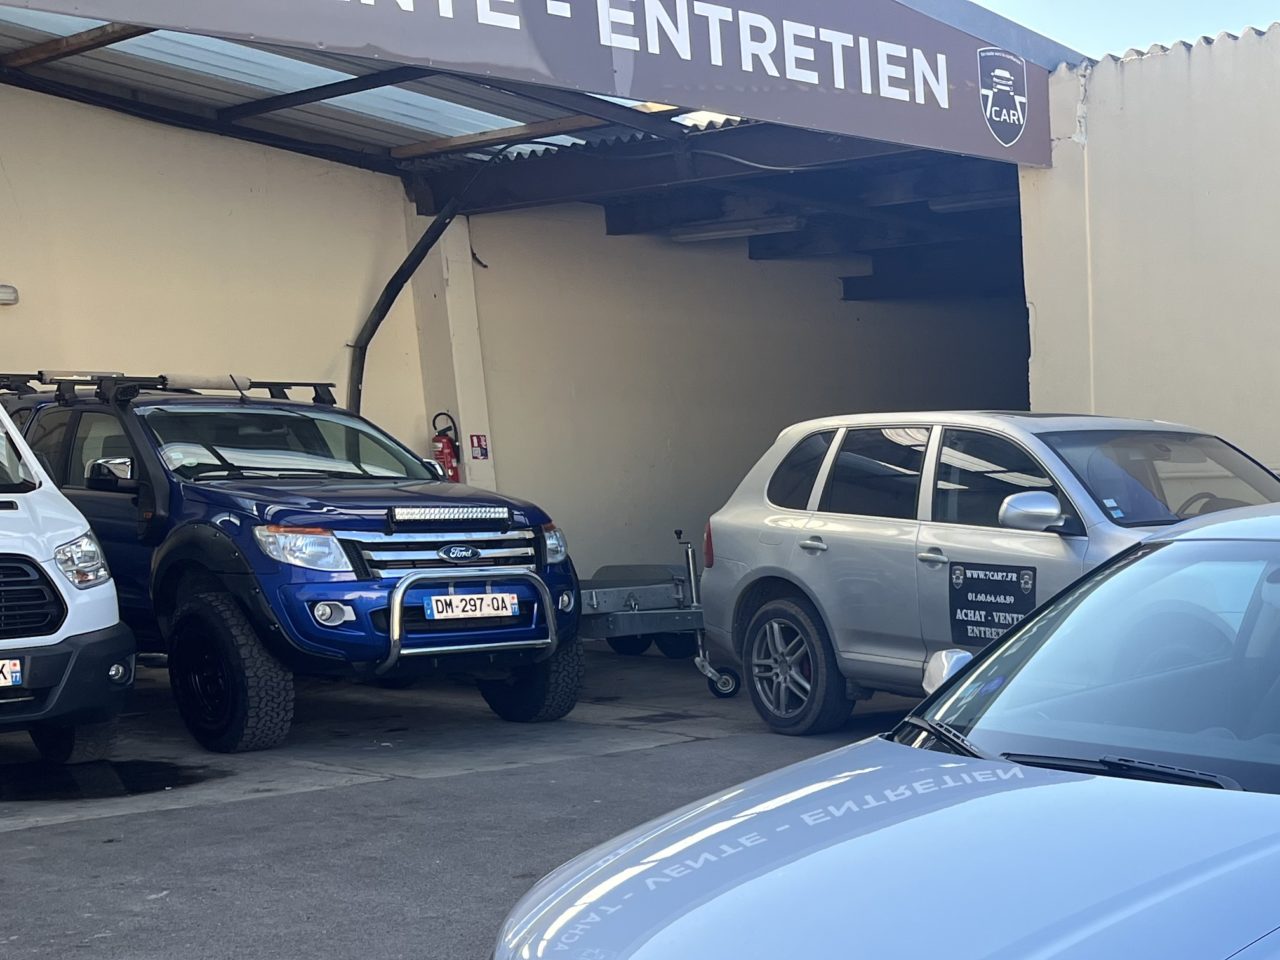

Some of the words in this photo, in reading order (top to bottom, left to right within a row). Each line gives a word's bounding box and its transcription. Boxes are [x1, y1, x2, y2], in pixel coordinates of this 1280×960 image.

[597, 0, 949, 109] ENTRETIEN
[449, 547, 472, 558] Ford
[965, 570, 1017, 581] WWW.7CAR7.FR
[956, 608, 986, 622] ACHAT
